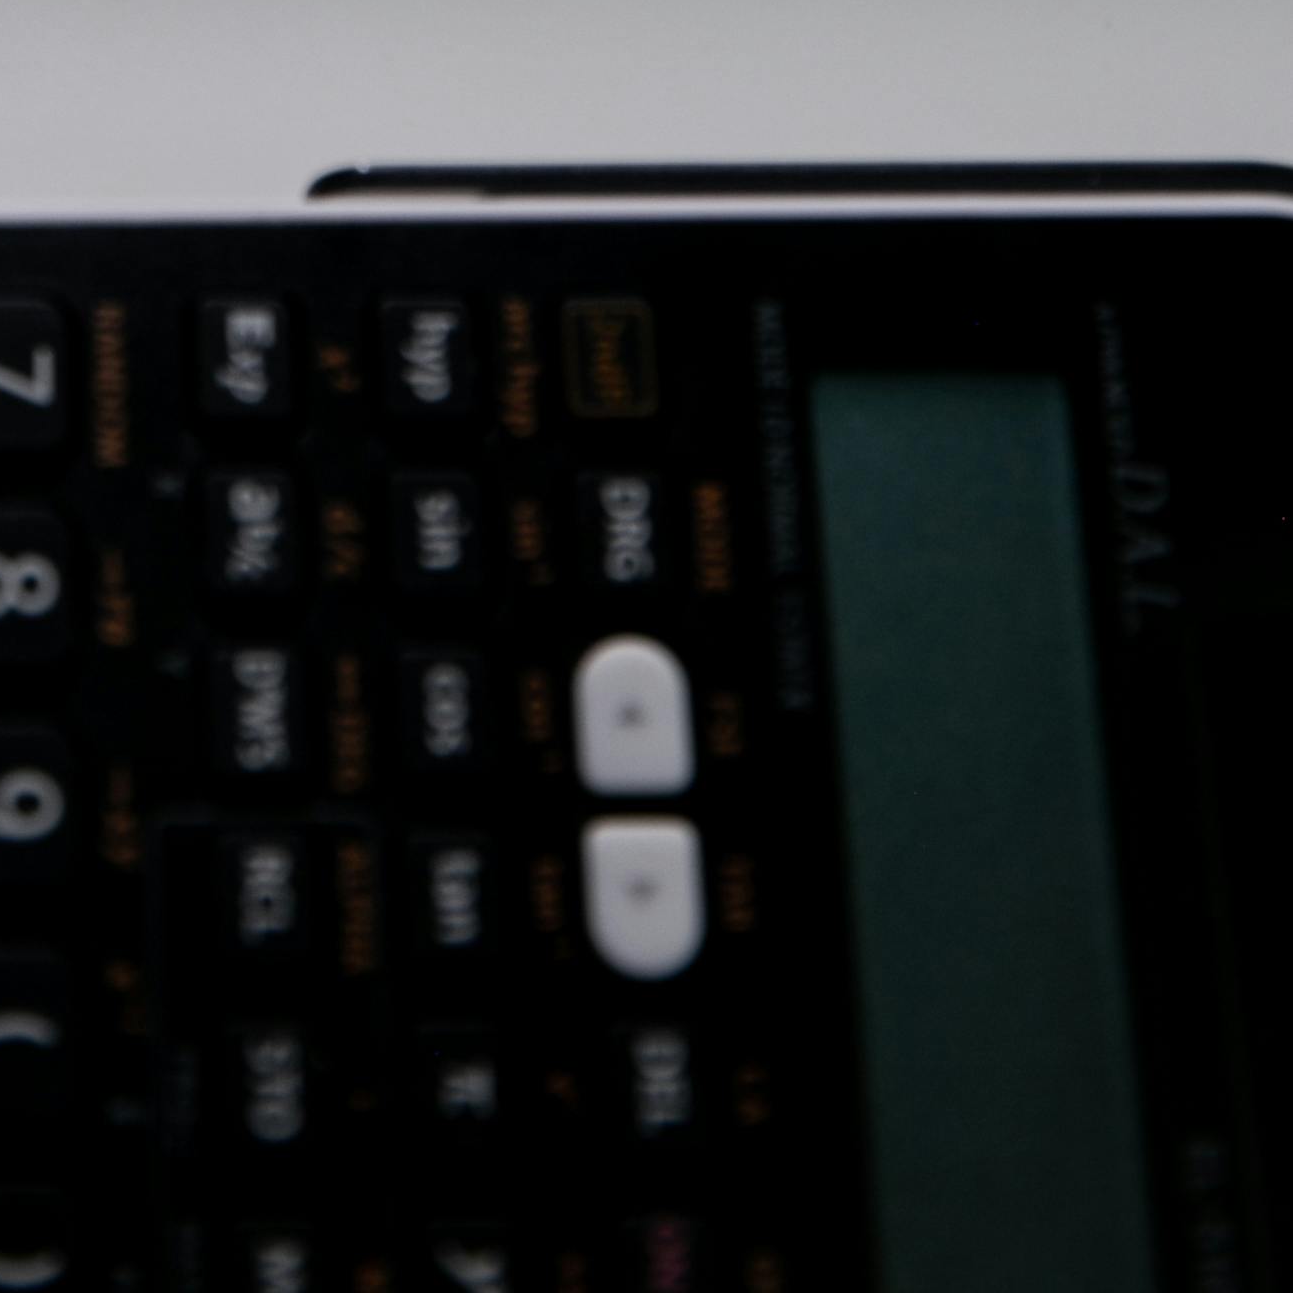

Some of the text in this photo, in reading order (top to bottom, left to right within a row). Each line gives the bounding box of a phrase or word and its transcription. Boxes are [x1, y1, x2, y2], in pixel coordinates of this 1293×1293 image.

[214, 306, 277, 405] Exp
[399, 309, 462, 403] hyp
[413, 488, 470, 573] sin
[598, 474, 652, 584] DRG
[421, 661, 470, 757] cos
[426, 848, 483, 949] tan
[241, 1033, 305, 1145] STO
